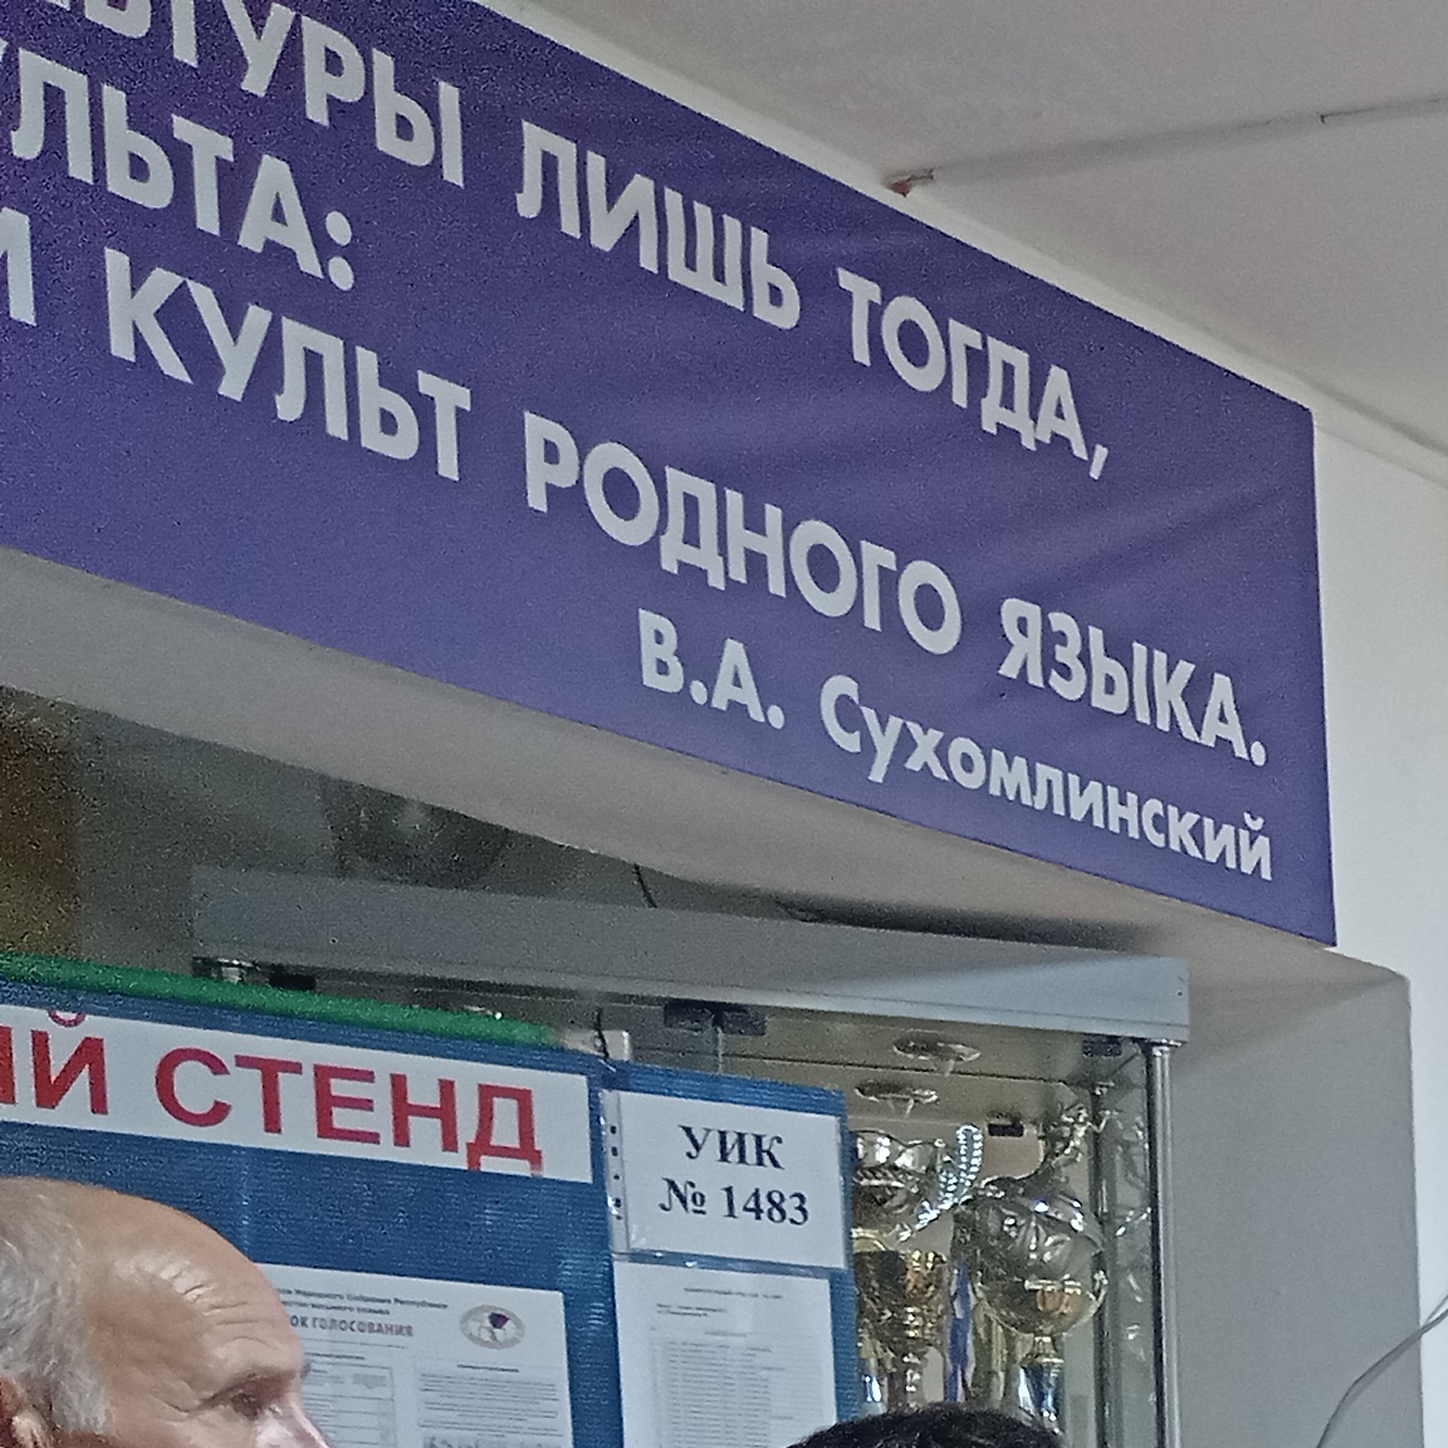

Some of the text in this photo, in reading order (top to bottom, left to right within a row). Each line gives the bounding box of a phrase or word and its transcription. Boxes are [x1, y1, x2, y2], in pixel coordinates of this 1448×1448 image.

[0, 36, 355, 292] ЛЬТА:
[515, 118, 801, 331] ЛИШЬ
[836, 266, 1109, 481] ТОГДА,
[105, 246, 471, 481] КУЛЬТ
[524, 410, 962, 655] РОДНОГО
[997, 597, 1267, 766] ЯЗЫКА.
[638, 608, 1272, 881] В.А. Сухомлинский
[155, 1047, 543, 1176] СТЕНД
[658, 1177, 809, 1226] № 1483
[678, 1124, 785, 1170] УИК
